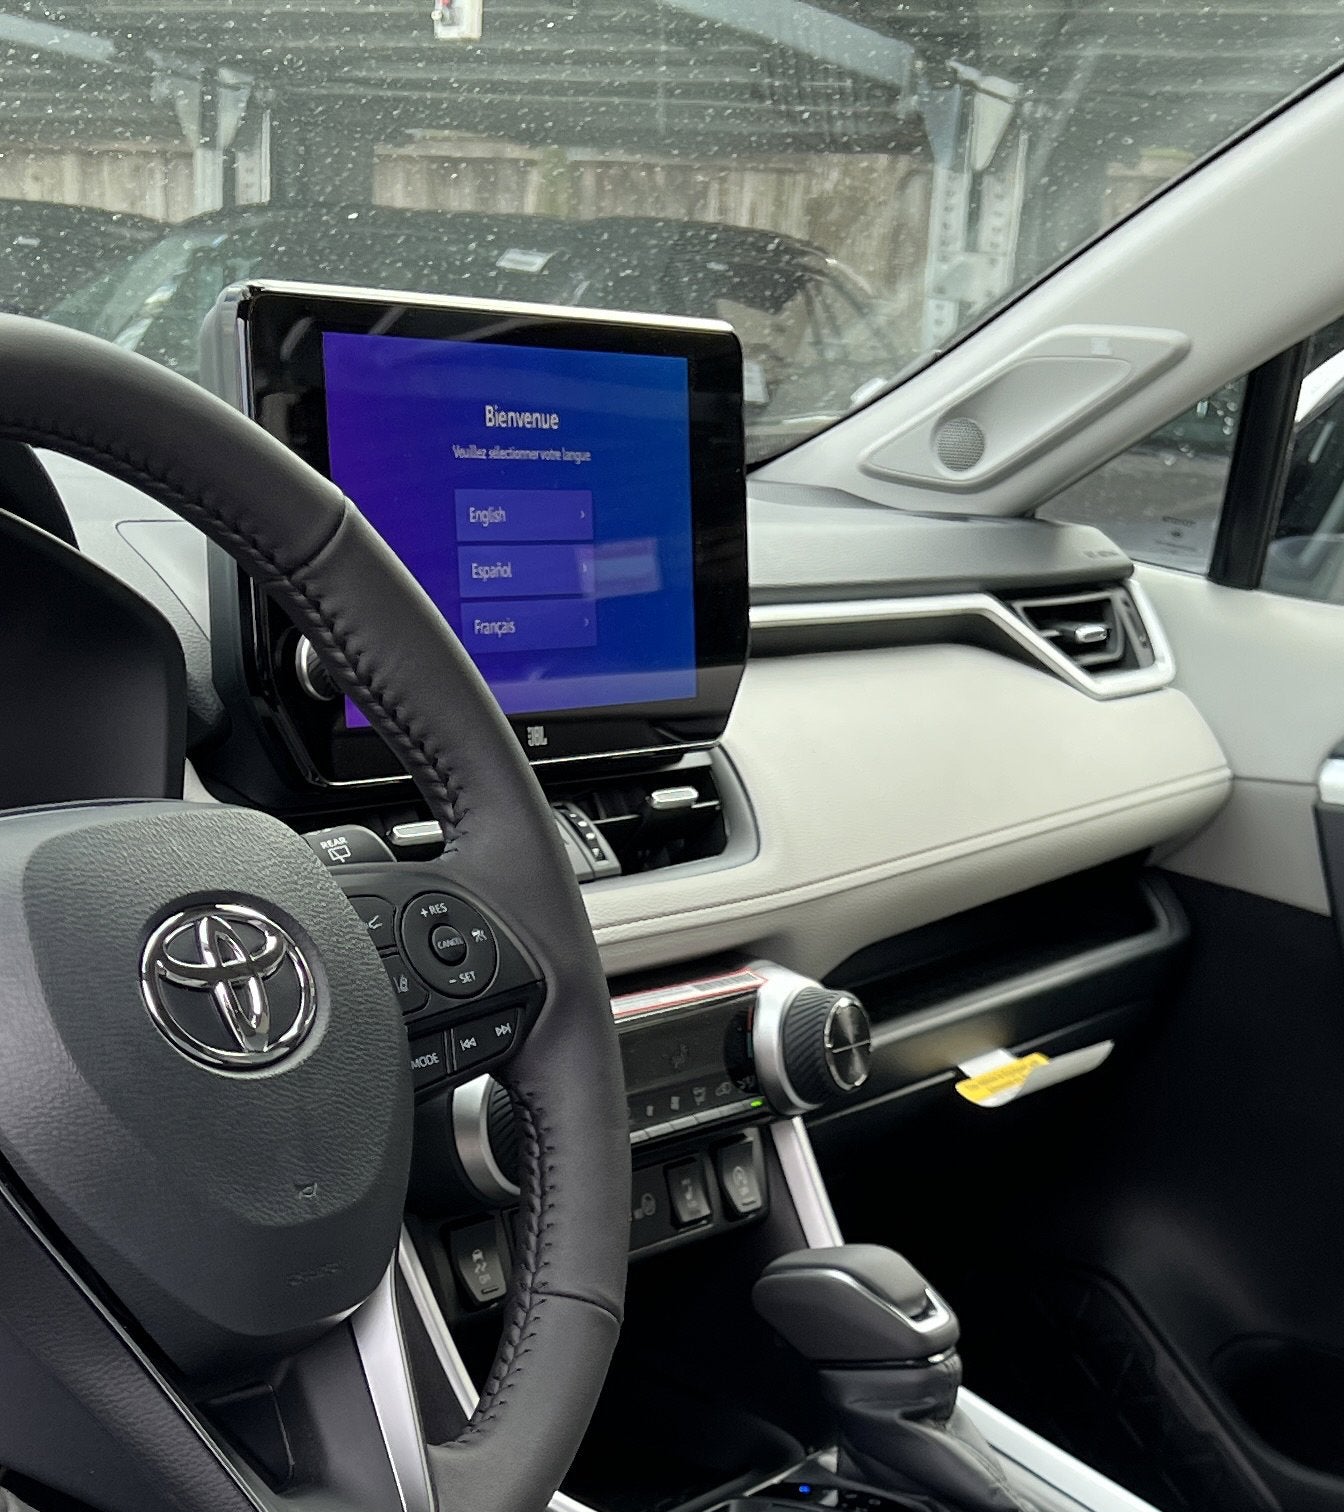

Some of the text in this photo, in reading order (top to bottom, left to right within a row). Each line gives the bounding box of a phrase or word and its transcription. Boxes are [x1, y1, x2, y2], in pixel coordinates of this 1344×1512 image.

[485, 405, 559, 429] Bienvenue
[452, 443, 592, 464] Veuillez sélectionner votre langue
[469, 507, 506, 526] English
[471, 562, 512, 583] Español
[474, 618, 516, 638] Français
[320, 836, 347, 850] REAR
[437, 936, 464, 950] CANCEL
[459, 970, 476, 985] SET
[410, 1052, 440, 1070] MODE
